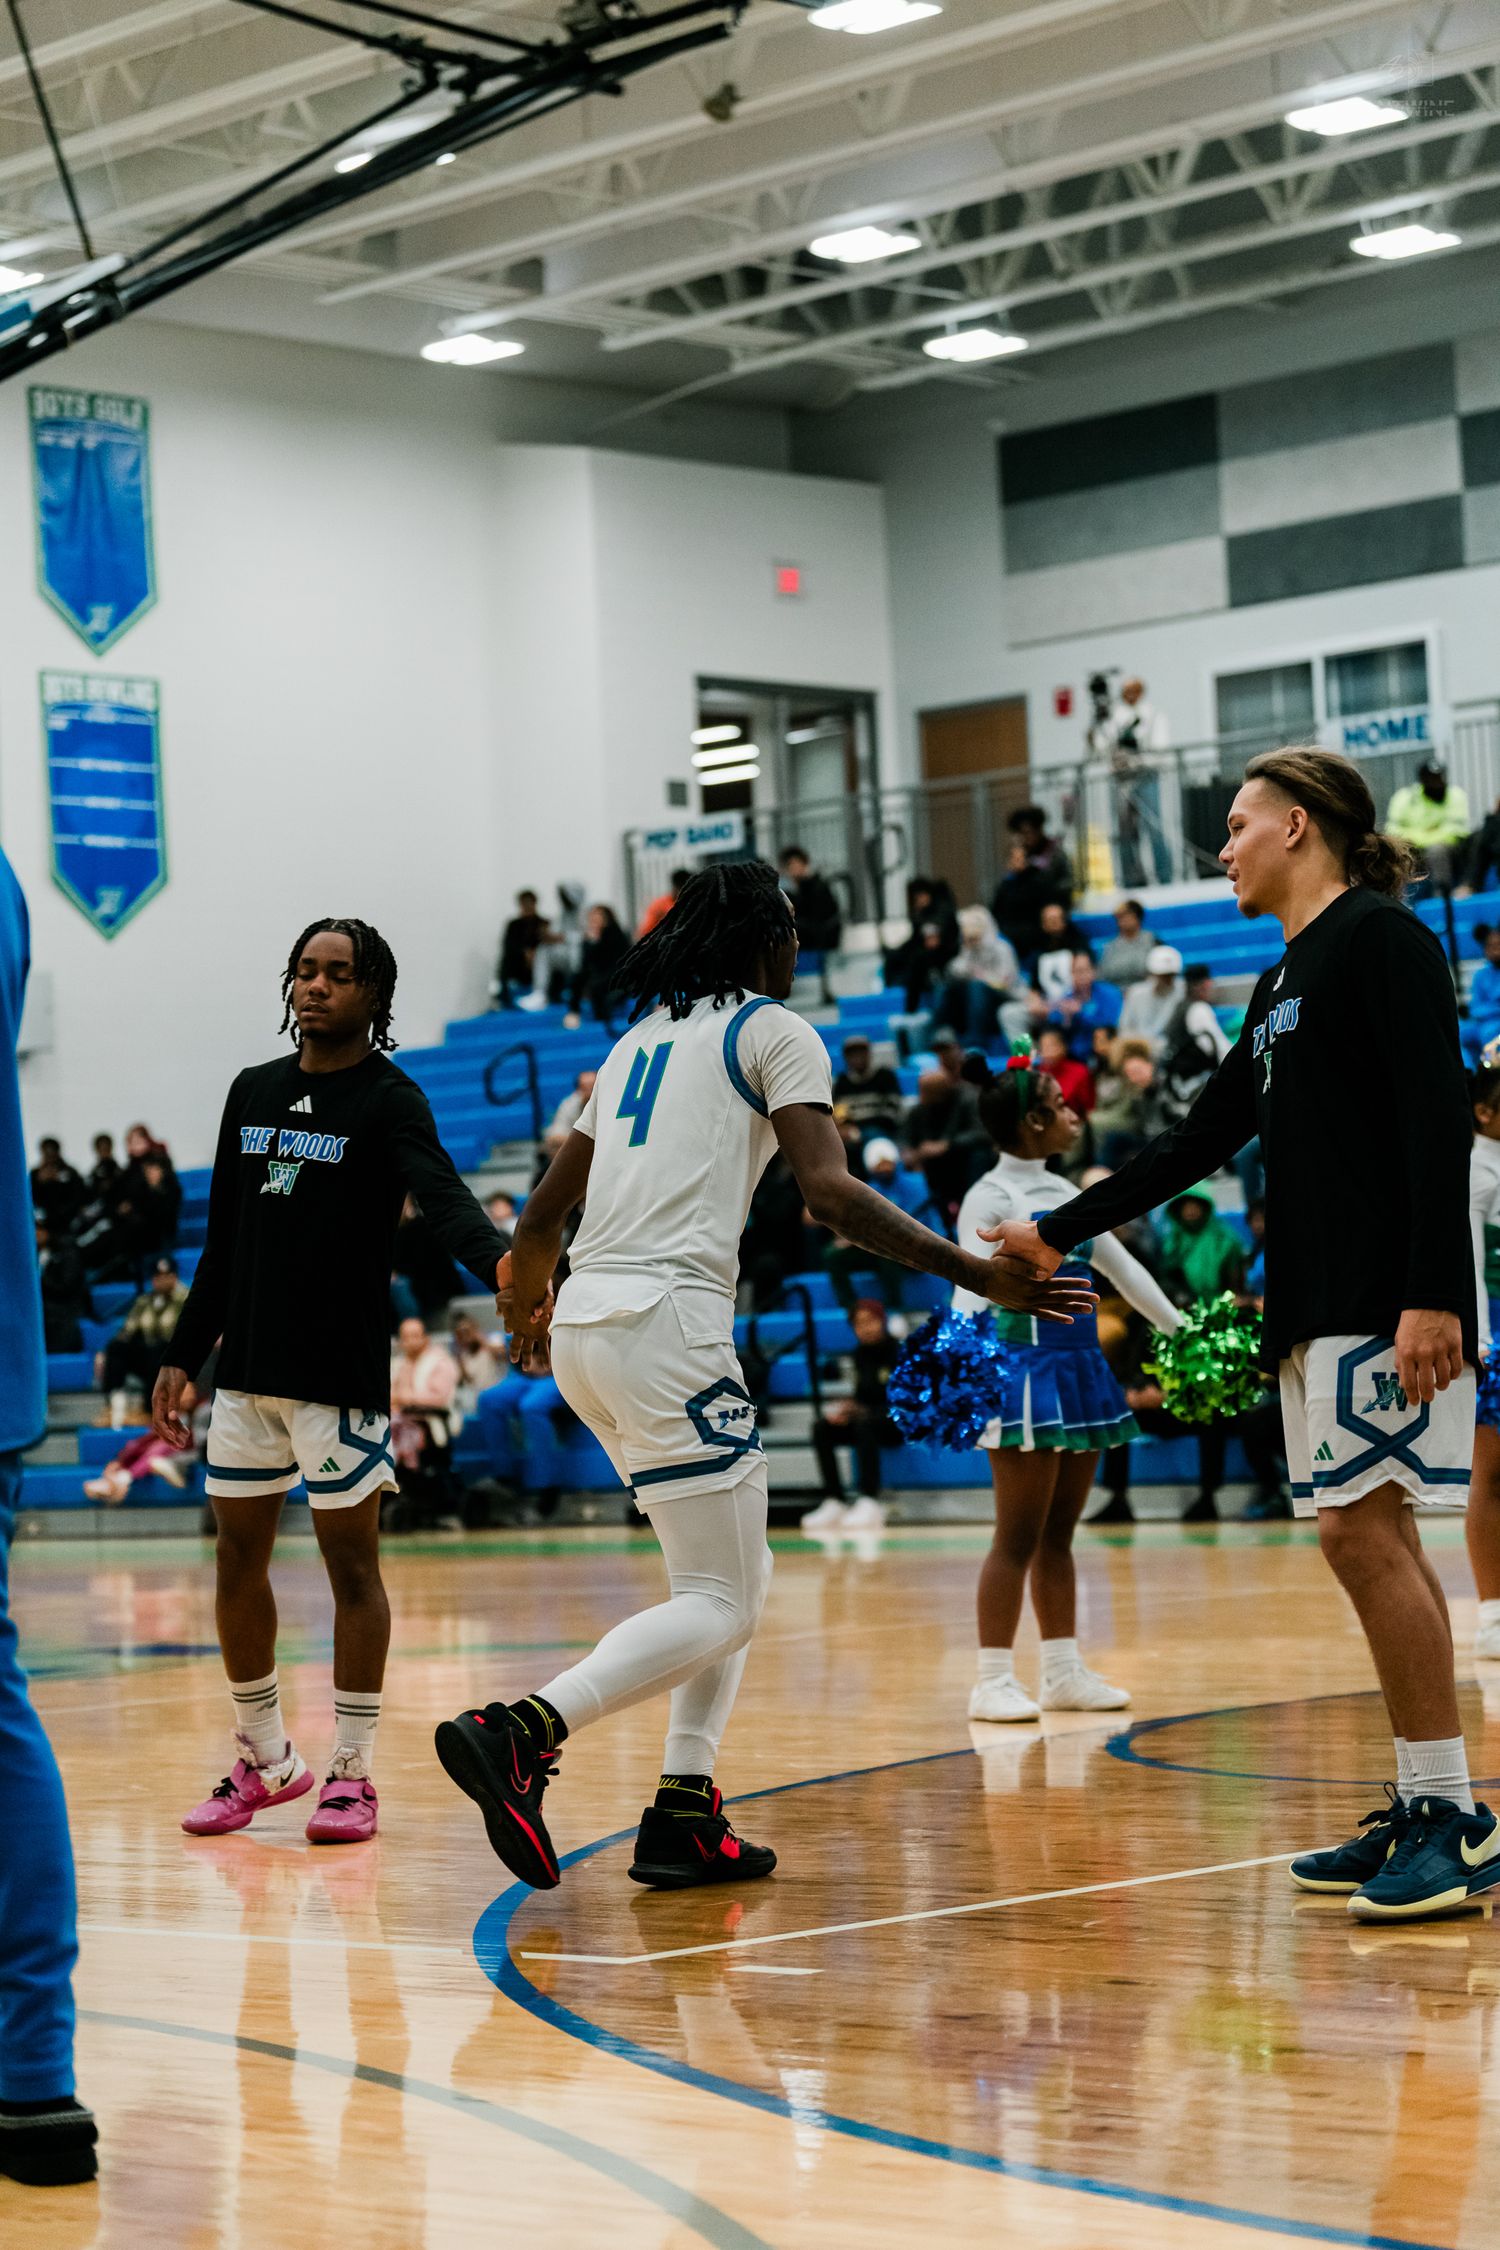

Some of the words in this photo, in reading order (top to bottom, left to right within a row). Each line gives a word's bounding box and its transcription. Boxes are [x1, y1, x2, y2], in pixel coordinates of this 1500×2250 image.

[1343, 714, 1429, 748] HOME
[615, 1040, 674, 1148] 4
[240, 1126, 276, 1154] THE
[277, 1128, 350, 1163] WOODS
